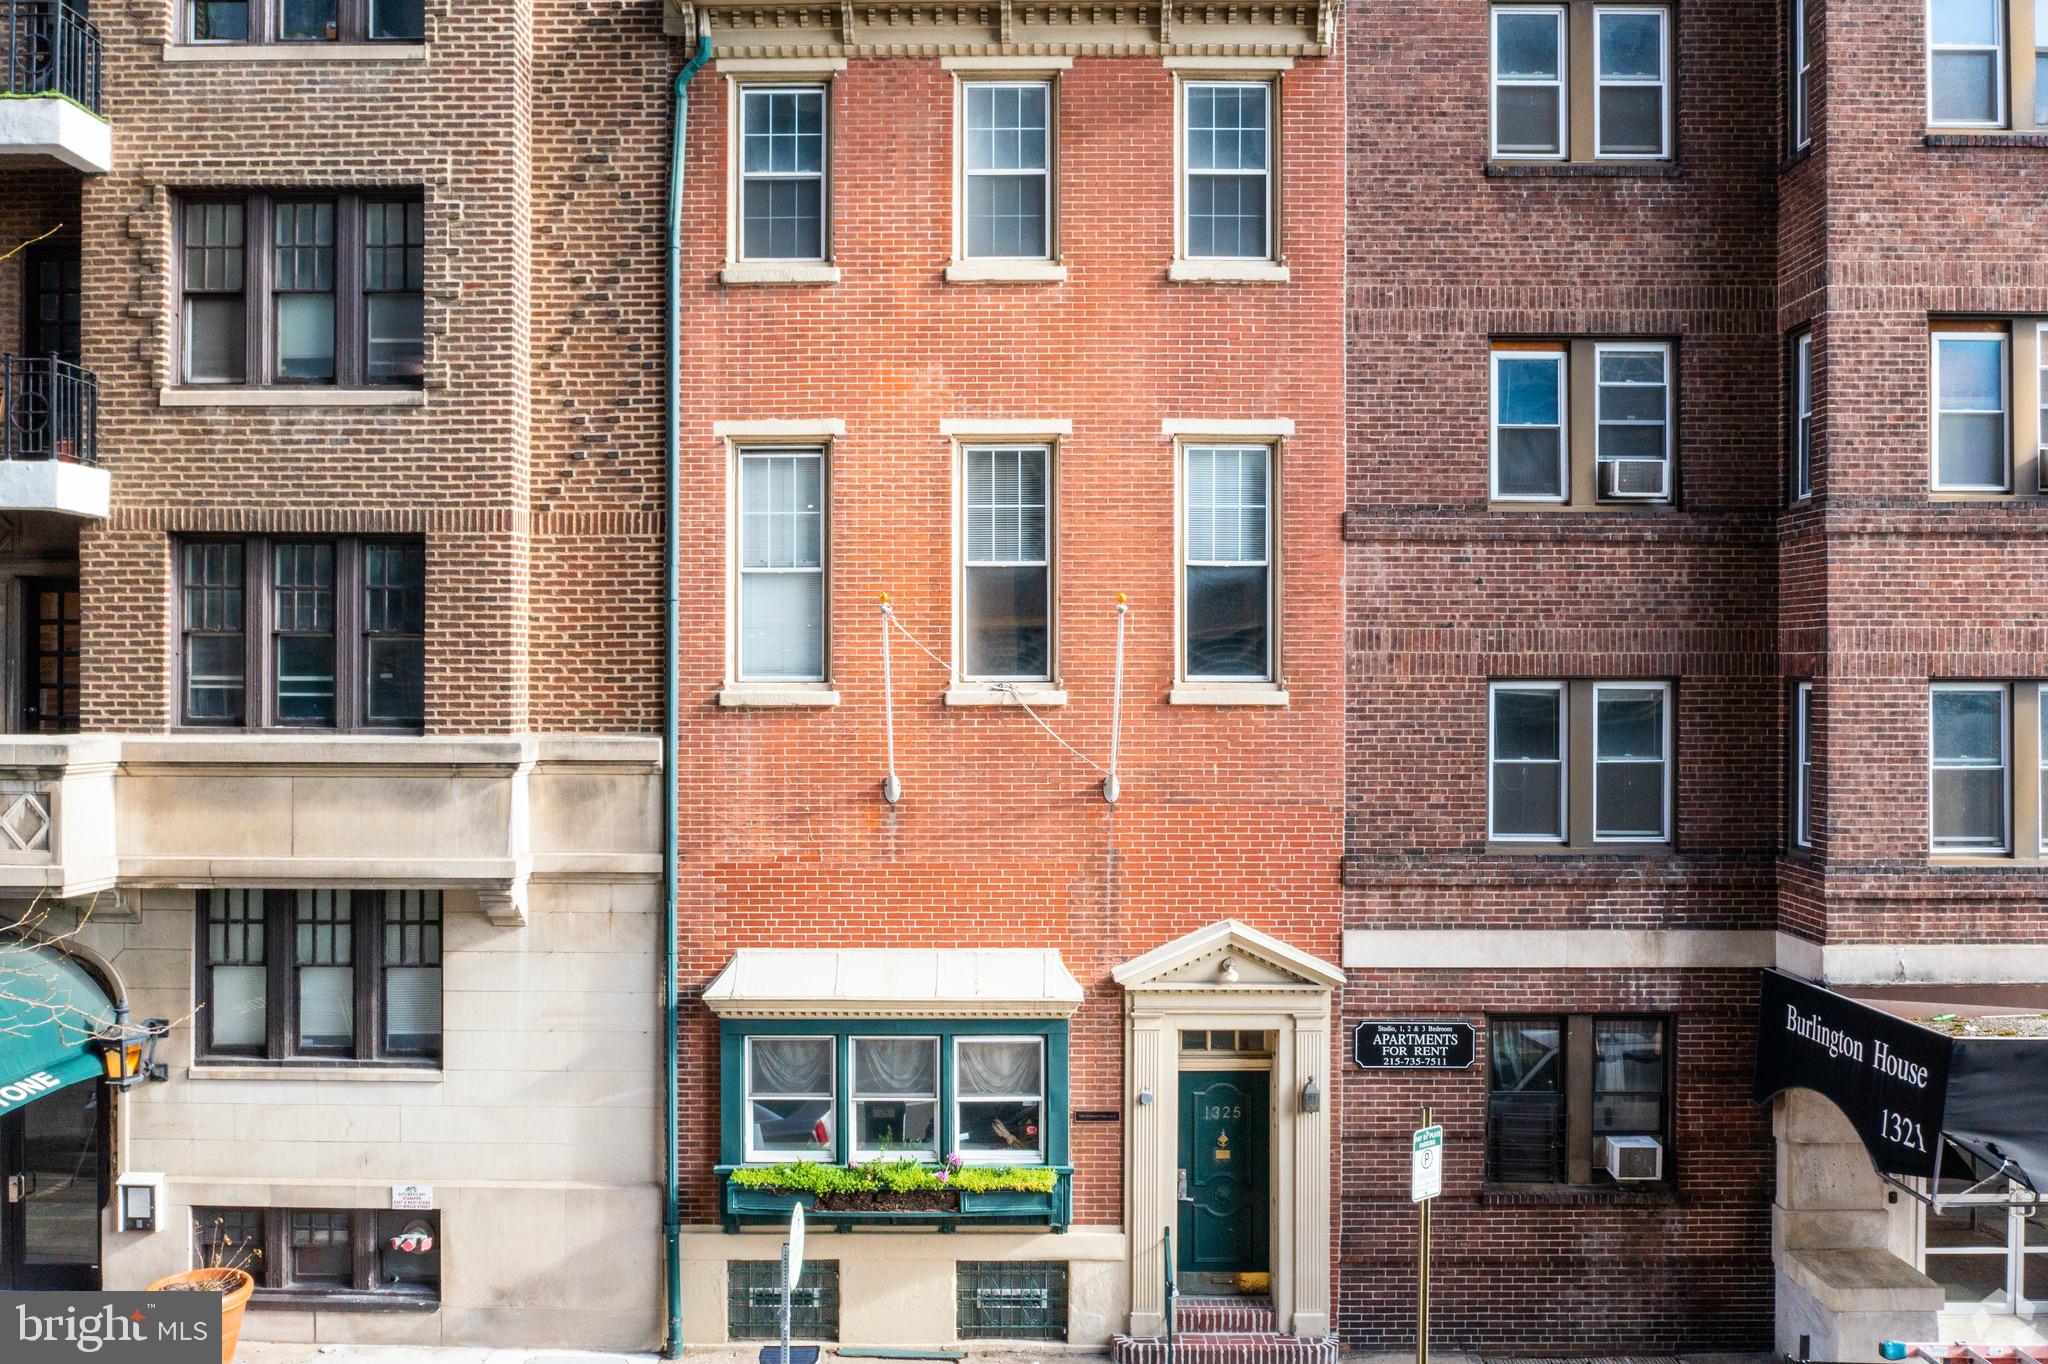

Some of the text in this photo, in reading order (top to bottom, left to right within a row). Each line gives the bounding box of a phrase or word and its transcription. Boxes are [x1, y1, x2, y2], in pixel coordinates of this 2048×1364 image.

[1372, 1033, 1458, 1046] APARTMENTS
[1786, 1003, 1928, 1088] Burlington House
[1382, 1046, 1448, 1056] FOR RENT
[1383, 1057, 1447, 1066] 215-735-7511
[1204, 1105, 1241, 1120] 1325
[1880, 1109, 1928, 1154] 1321
